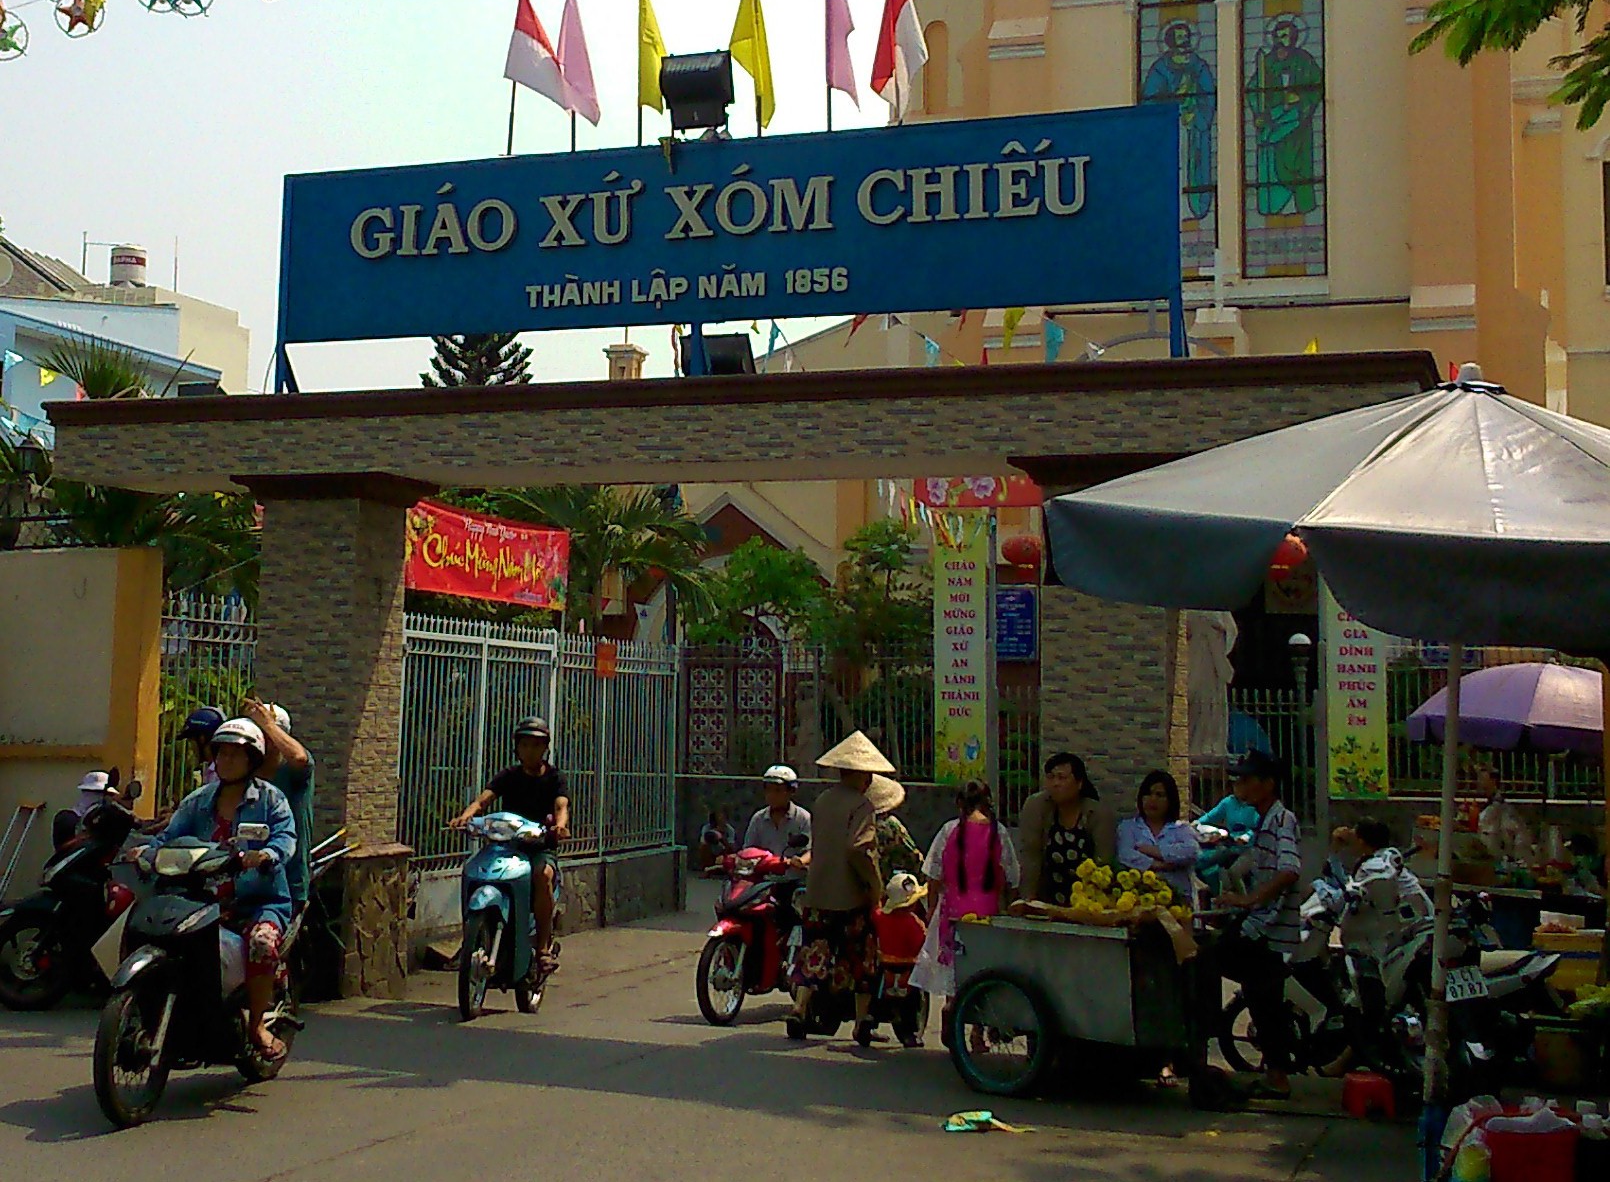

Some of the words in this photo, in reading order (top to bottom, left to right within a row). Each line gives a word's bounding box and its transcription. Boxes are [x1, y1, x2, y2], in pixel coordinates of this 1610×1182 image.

[350, 182, 516, 258] GIÁO
[538, 170, 642, 248] XỨ
[664, 163, 835, 239] XÓM
[857, 138, 1091, 225] CHIẾU
[525, 274, 621, 309] THÀNH
[631, 267, 689, 310] LẬP
[698, 263, 766, 300] NĂM
[785, 267, 849, 294] 1856
[422, 533, 465, 569] Chúc
[945, 622, 974, 635] GIÁO
[1343, 628, 1368, 639] GIA
[951, 658, 968, 668] AN
